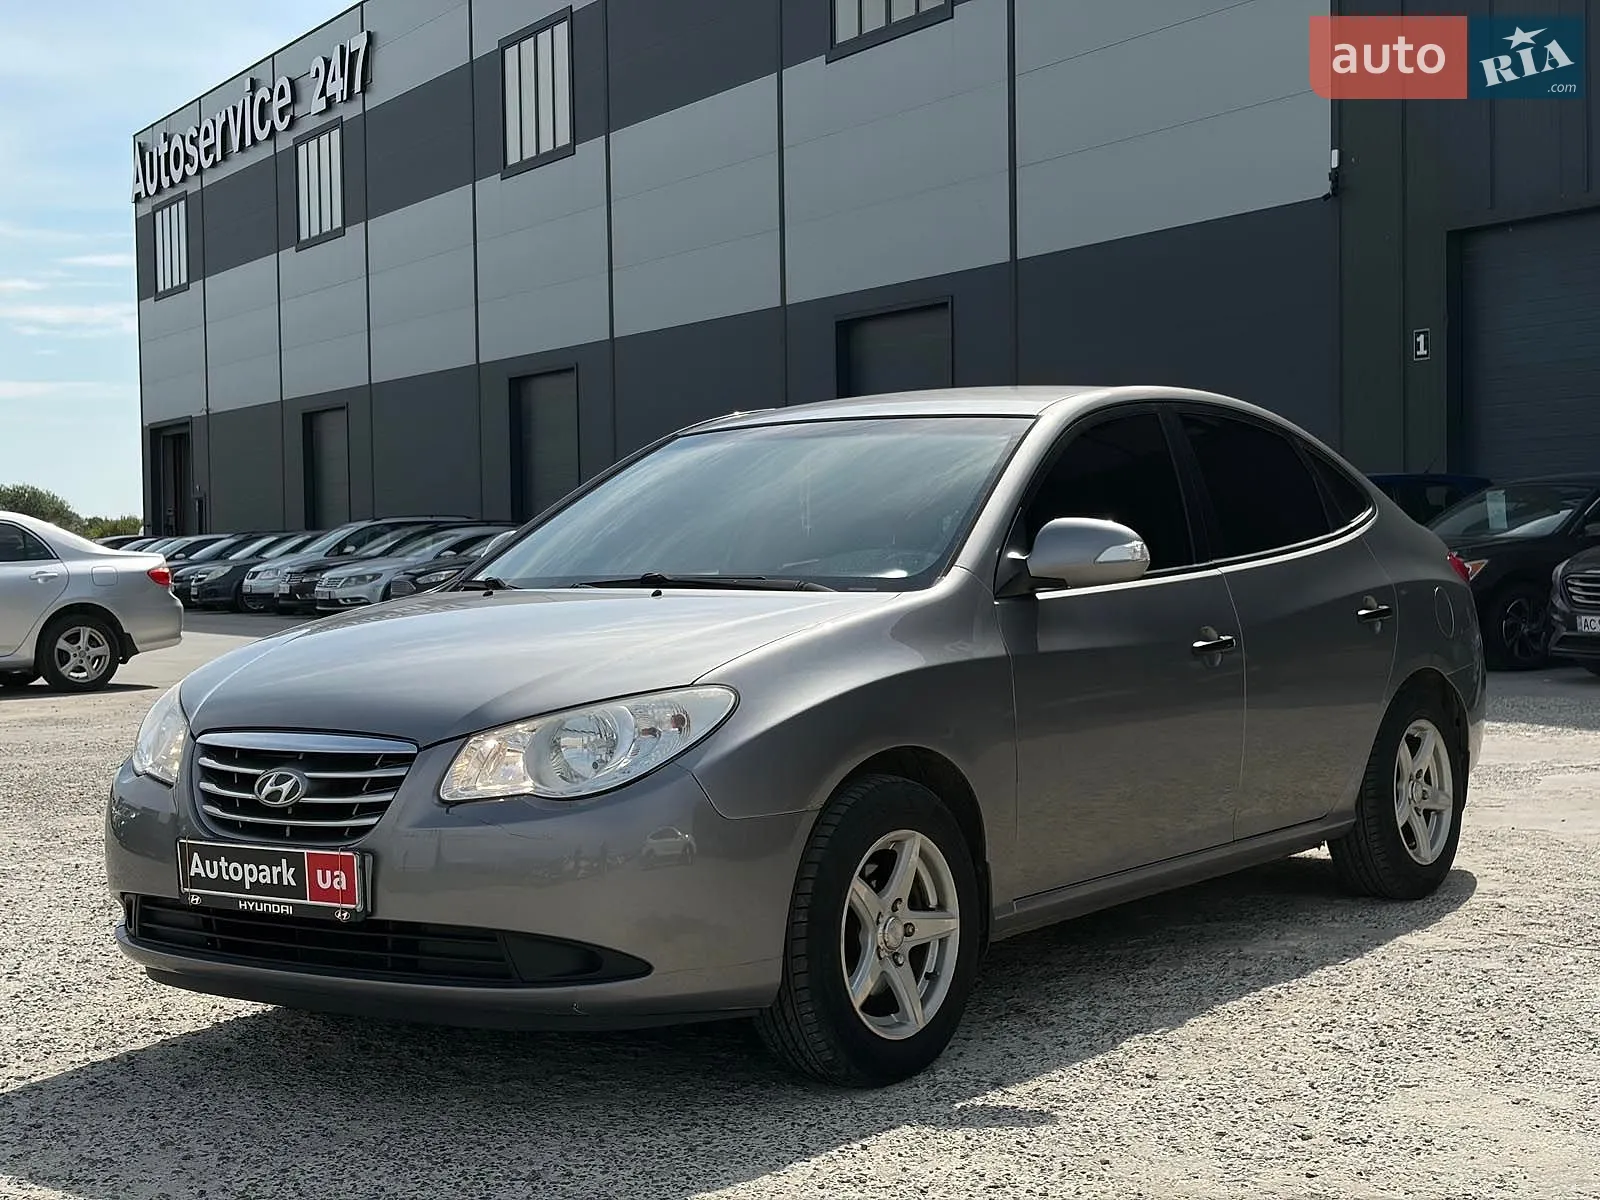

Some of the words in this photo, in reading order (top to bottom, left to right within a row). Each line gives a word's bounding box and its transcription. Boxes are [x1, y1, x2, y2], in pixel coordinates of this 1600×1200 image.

[133, 76, 293, 199] Autoservice
[310, 30, 371, 116] 24/7
[1416, 333, 1428, 356] 1
[190, 852, 297, 889] Autopark
[316, 868, 347, 890] ua
[238, 900, 294, 915] HYUNDAI
